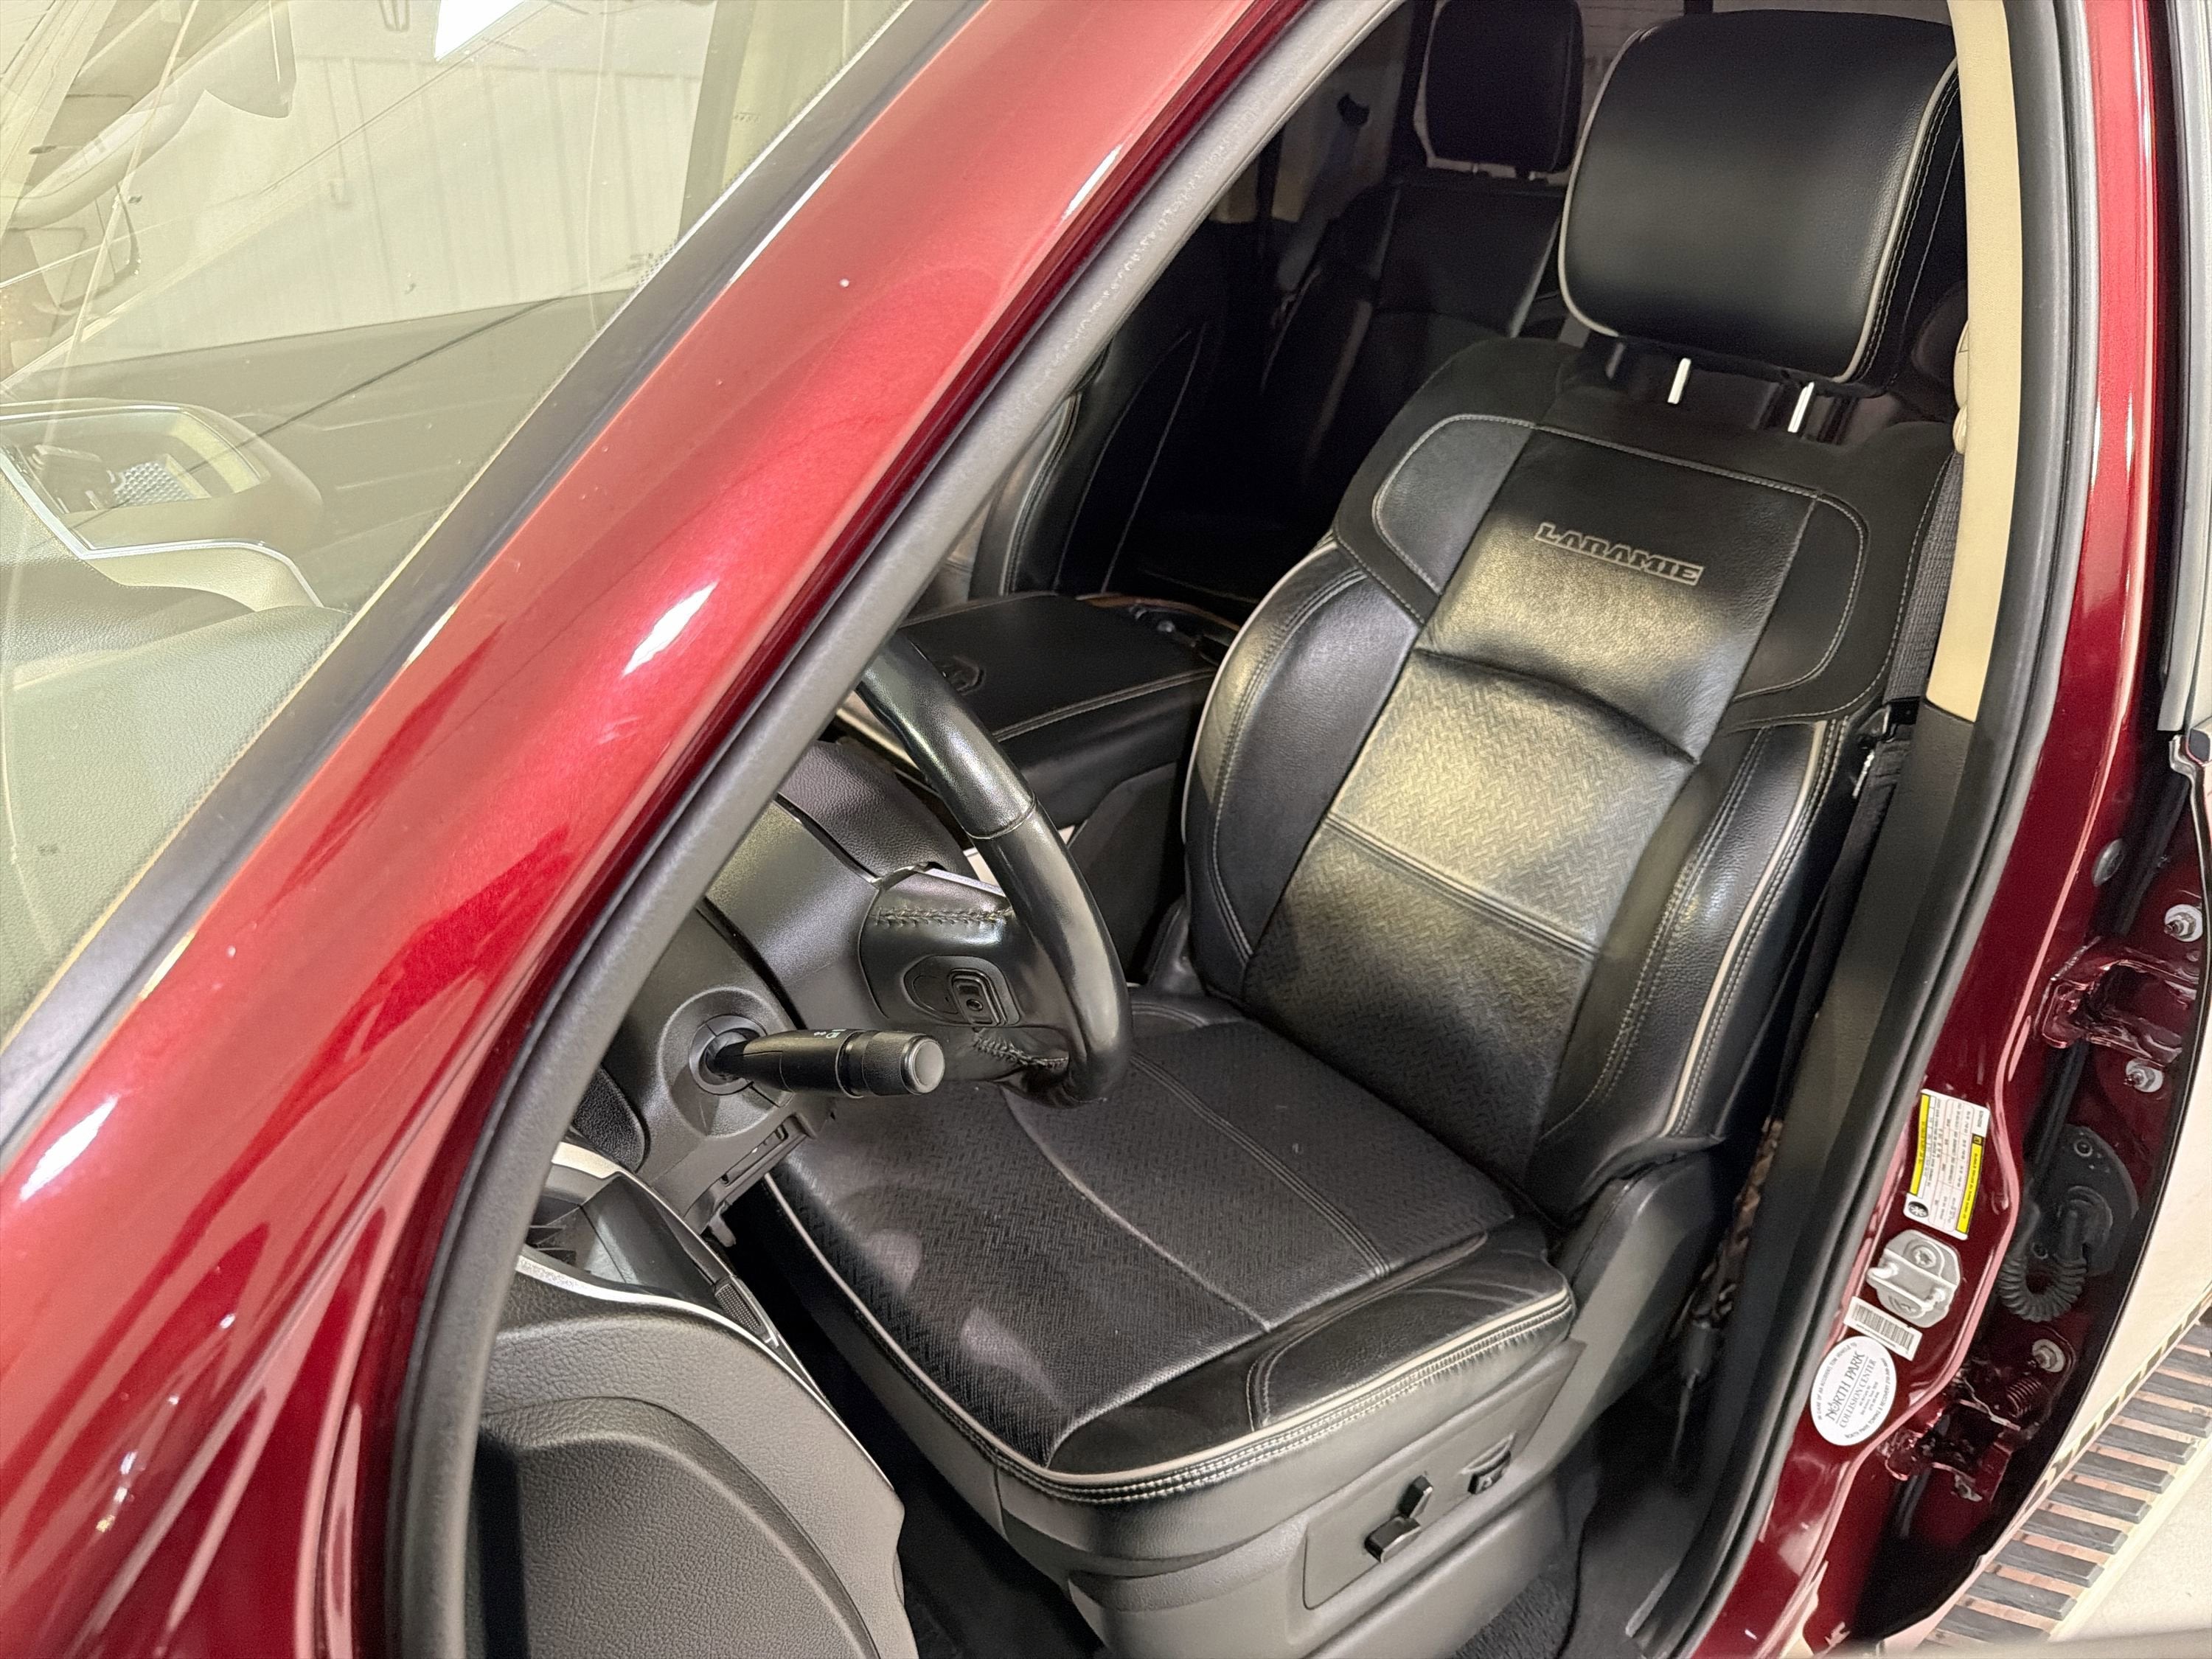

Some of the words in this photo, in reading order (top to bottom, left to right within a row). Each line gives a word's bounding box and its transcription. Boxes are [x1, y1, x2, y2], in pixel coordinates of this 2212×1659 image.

[1534, 521, 1704, 586] LARAMIE
[1825, 1380, 1851, 1422] NORTH
[1844, 1351, 1865, 1381] PARK
[1839, 1388, 1863, 1428] COLLISION
[1859, 1359, 1877, 1388] CENTER
